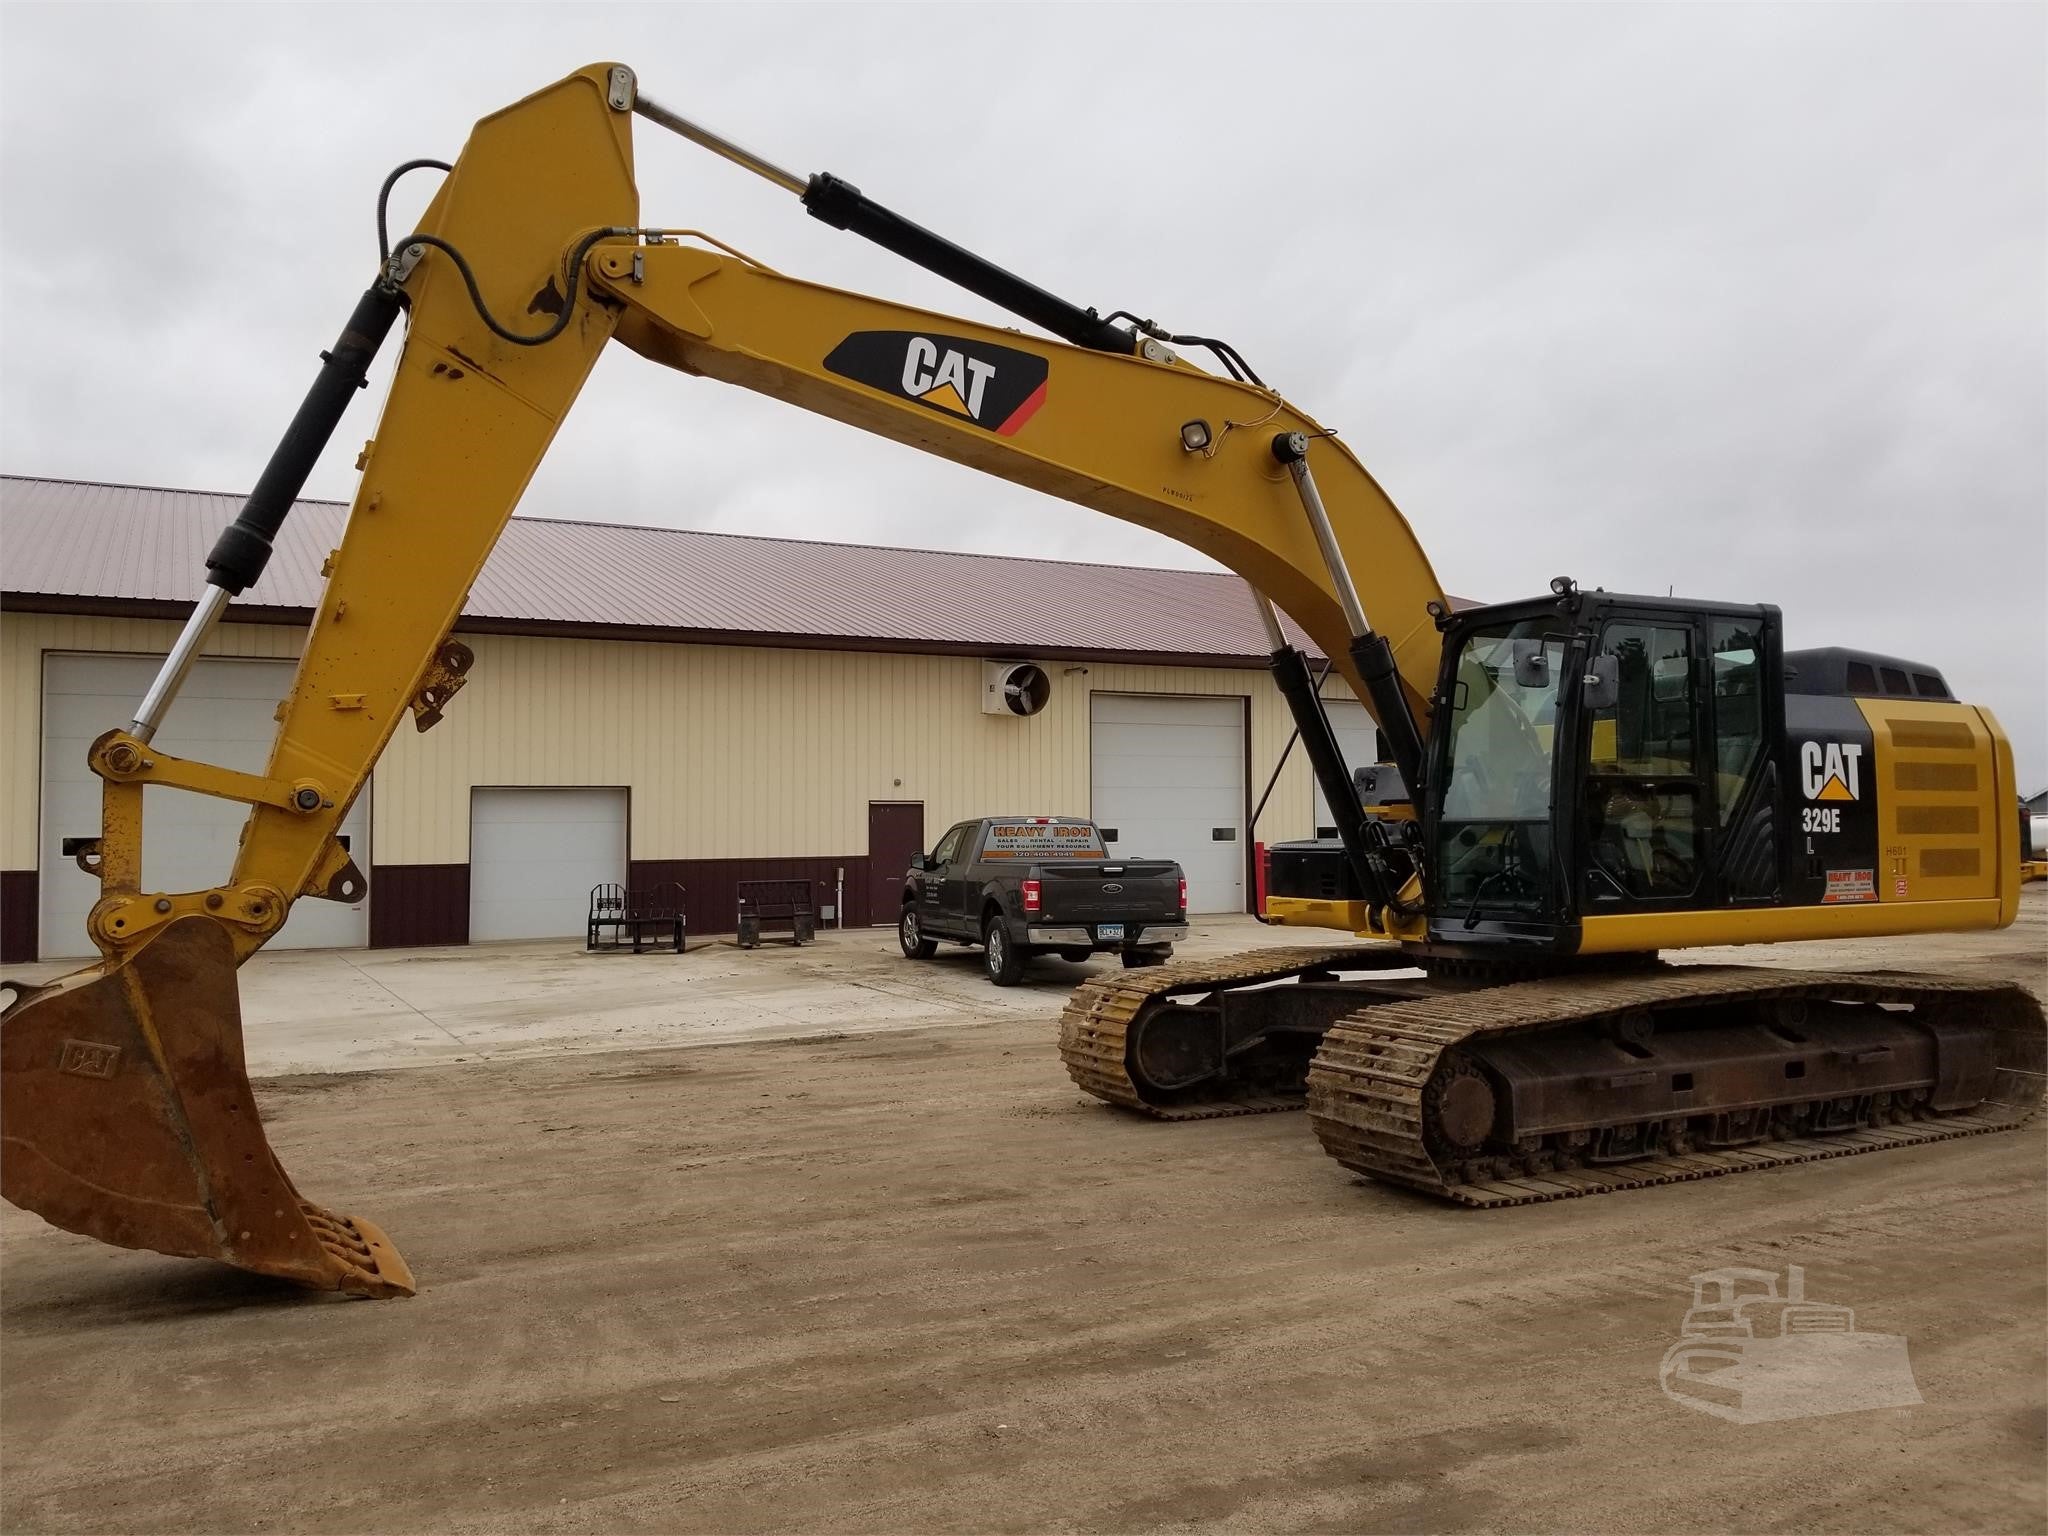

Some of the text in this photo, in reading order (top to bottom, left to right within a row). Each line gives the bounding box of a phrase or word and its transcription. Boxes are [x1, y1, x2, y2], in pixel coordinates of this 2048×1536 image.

[902, 337, 996, 420] CAT
[1801, 741, 1862, 800] CAT
[993, 826, 1092, 837] HEAVY IRON
[1802, 808, 1840, 832] 329E
[1806, 836, 1815, 855] L
